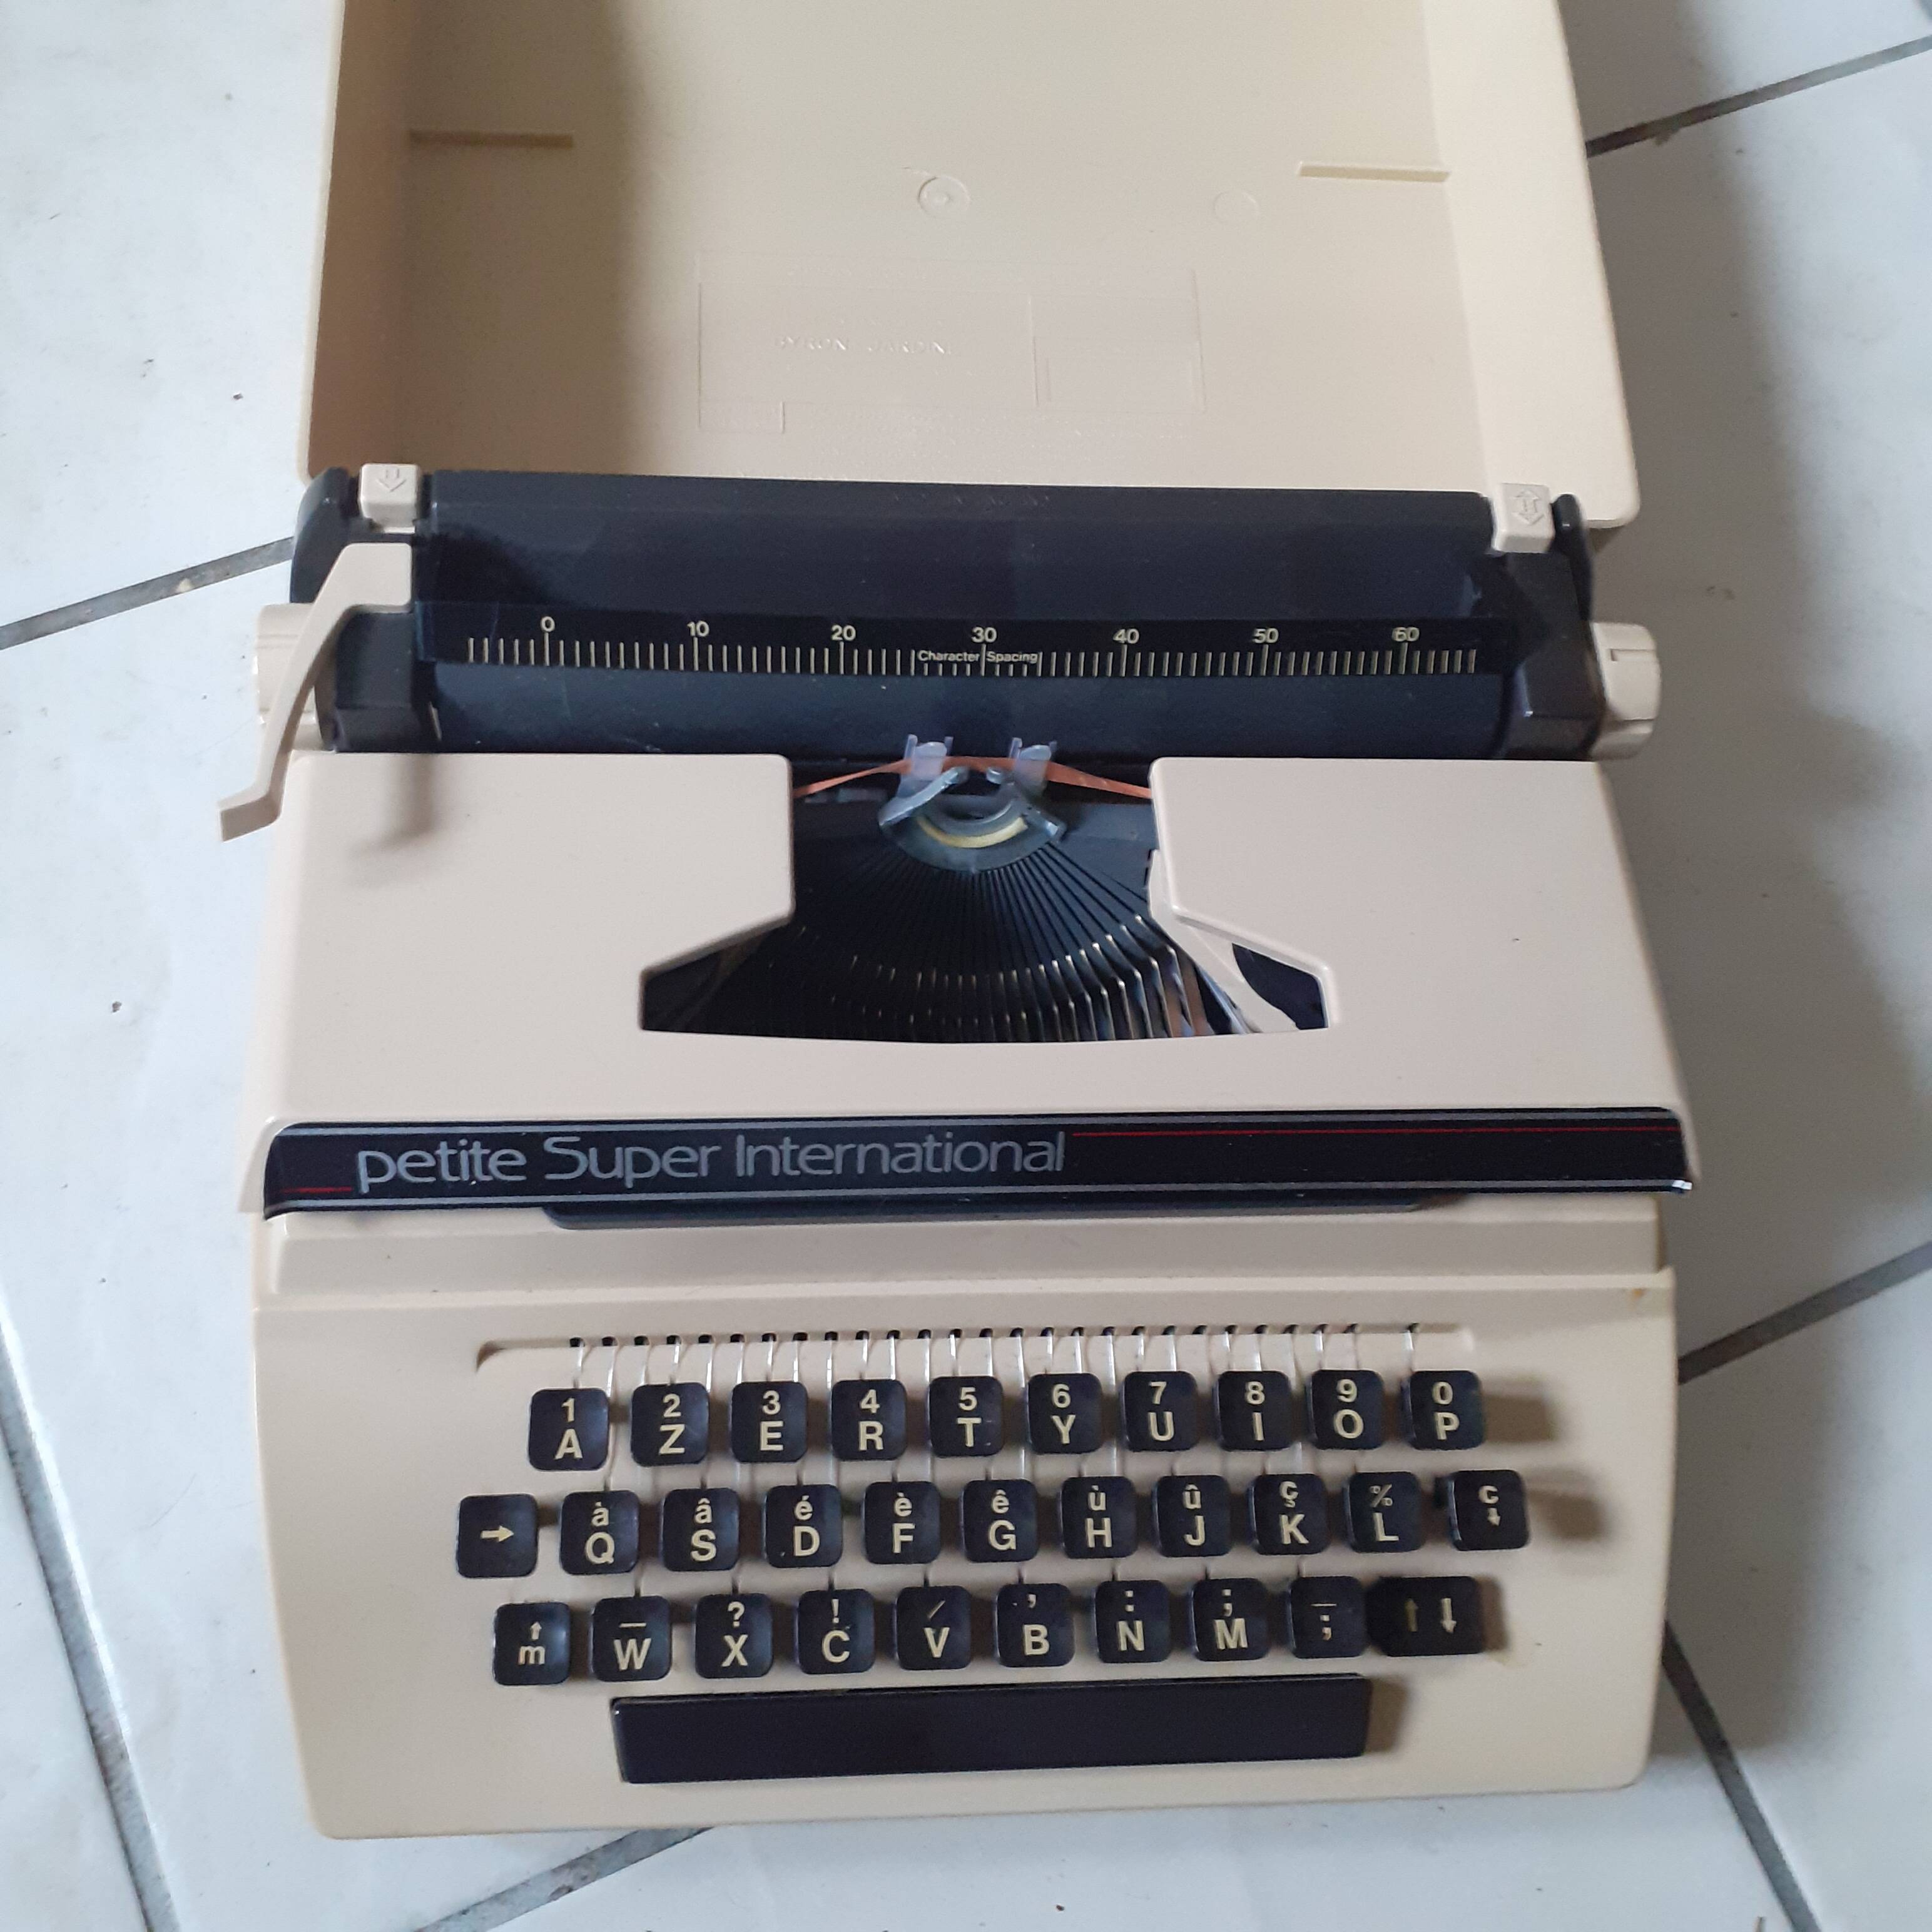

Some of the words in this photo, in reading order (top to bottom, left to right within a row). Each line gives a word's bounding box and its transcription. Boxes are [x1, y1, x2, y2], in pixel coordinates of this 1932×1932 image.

[541, 616, 555, 633] 0
[687, 620, 709, 637] 10
[831, 624, 856, 641] 20
[971, 626, 997, 643] 30
[1113, 628, 1139, 644] 40
[1253, 628, 1279, 643] 50
[1393, 627, 1420, 642] 60
[918, 649, 980, 662] Character
[986, 651, 1039, 664] Spacing
[356, 1141, 527, 1194] petite
[543, 1136, 722, 1189] Super
[736, 1132, 1065, 1177] International
[762, 1390, 781, 1415] 3
[860, 1389, 880, 1413] 4
[958, 1386, 977, 1411] 5
[1052, 1383, 1071, 1408] 6
[1149, 1381, 1167, 1405] 7
[1246, 1381, 1265, 1405] 8
[1338, 1378, 1357, 1403] 9
[1433, 1381, 1453, 1405] 0
[562, 1398, 575, 1422] 1
[663, 1393, 681, 1418] 2
[760, 1420, 784, 1451] E
[858, 1421, 883, 1451] R
[957, 1417, 982, 1447] T
[1051, 1414, 1076, 1444] Y
[1148, 1411, 1174, 1441] U
[1253, 1412, 1264, 1441] I
[1334, 1409, 1364, 1439] O
[1435, 1412, 1460, 1440] P
[555, 1428, 583, 1460] A
[659, 1423, 685, 1455] Z
[794, 1495, 813, 1520] é
[894, 1492, 912, 1517] è
[991, 1489, 1009, 1513] ê
[1089, 1485, 1106, 1511] ù
[1184, 1483, 1201, 1509] û
[1279, 1481, 1298, 1508] ç
[1370, 1484, 1393, 1508] %
[591, 1502, 609, 1527] à
[694, 1498, 712, 1524] â
[794, 1525, 820, 1557] D
[892, 1523, 915, 1553] F
[989, 1520, 1017, 1550] G
[1086, 1517, 1112, 1548] H
[1185, 1515, 1205, 1546] J
[1281, 1513, 1309, 1545] K
[1374, 1512, 1399, 1542] L
[584, 1532, 615, 1564] Q
[691, 1528, 717, 1562] S
[727, 1601, 745, 1628] ?
[832, 1599, 840, 1624] !
[1125, 1590, 1134, 1613] :
[821, 1630, 850, 1663] C
[924, 1627, 950, 1658] V
[1023, 1624, 1050, 1655] B
[1118, 1620, 1145, 1651] N
[1214, 1618, 1248, 1650] M
[614, 1637, 652, 1670] W
[721, 1634, 748, 1667] X
